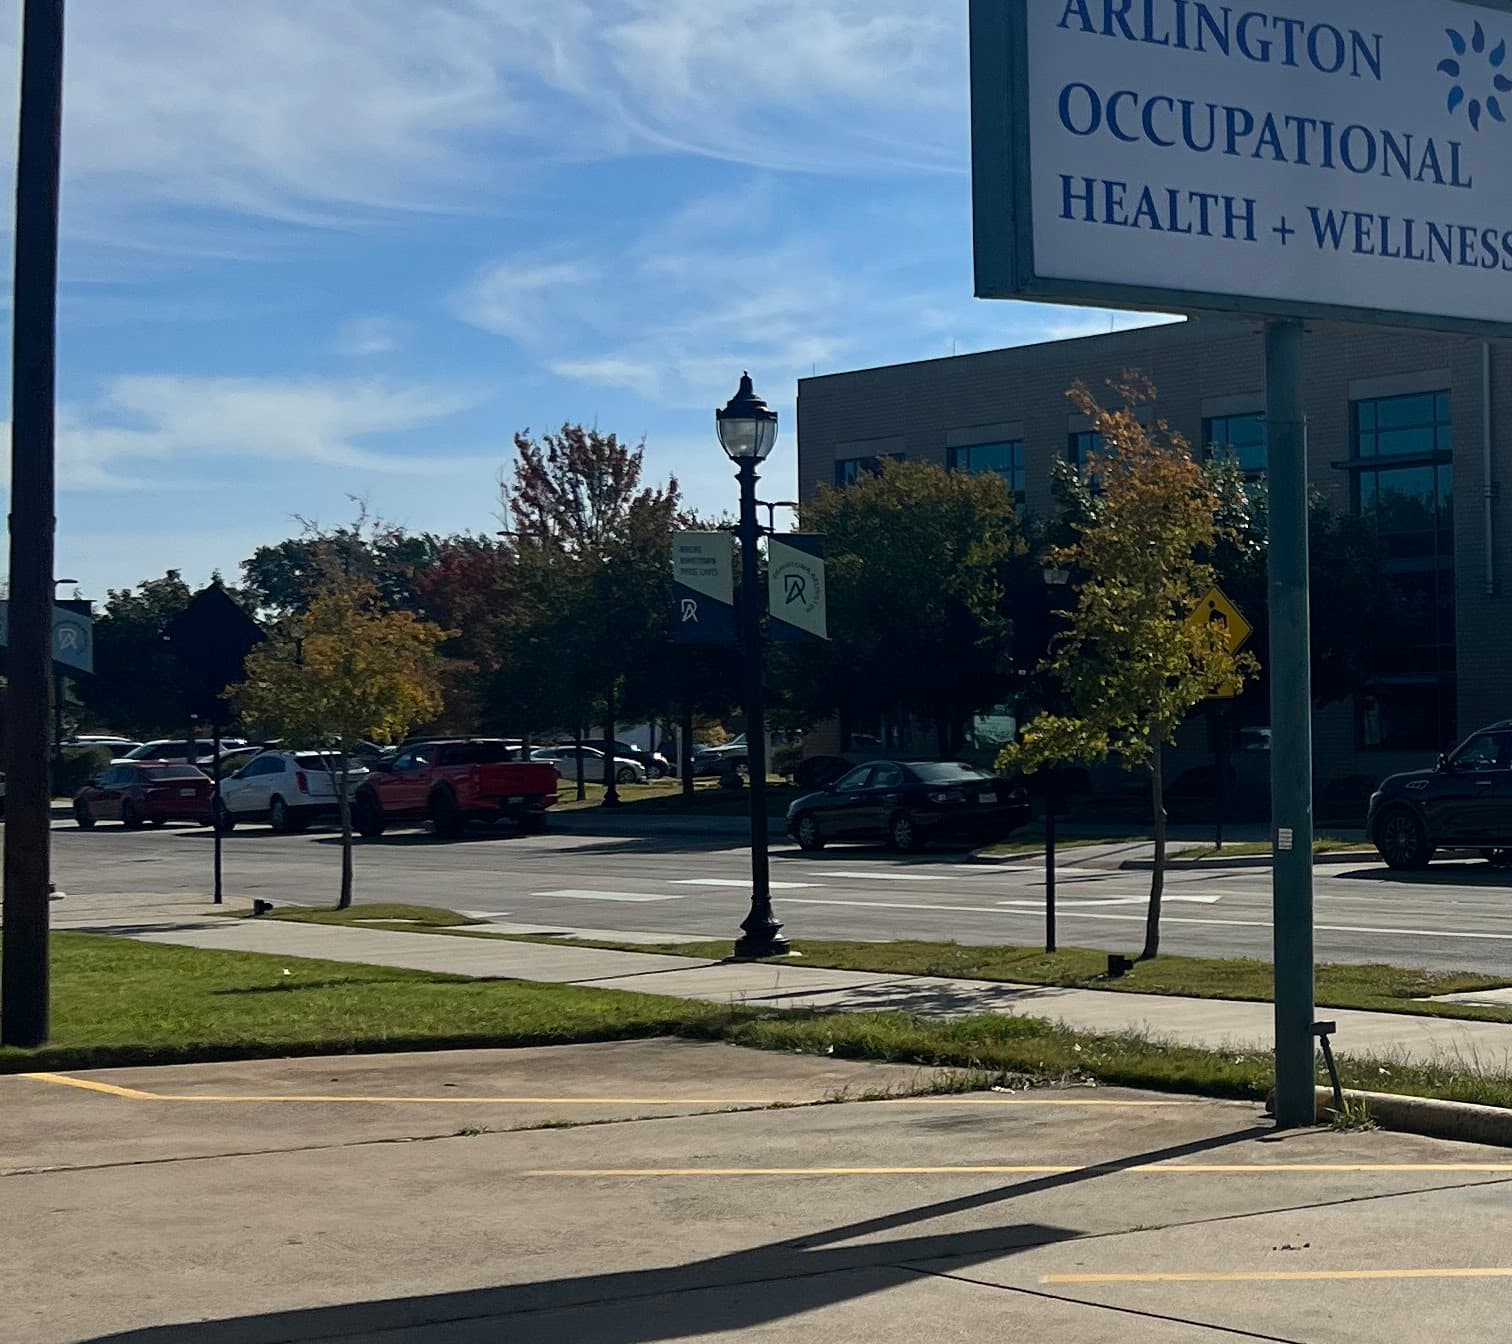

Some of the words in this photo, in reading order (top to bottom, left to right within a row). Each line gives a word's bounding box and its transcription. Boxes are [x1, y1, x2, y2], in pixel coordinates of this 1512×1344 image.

[1057, 81, 1473, 190] OCCUPATIONAL
[1057, 173, 1258, 242] HEALTH
[1271, 215, 1296, 246] +
